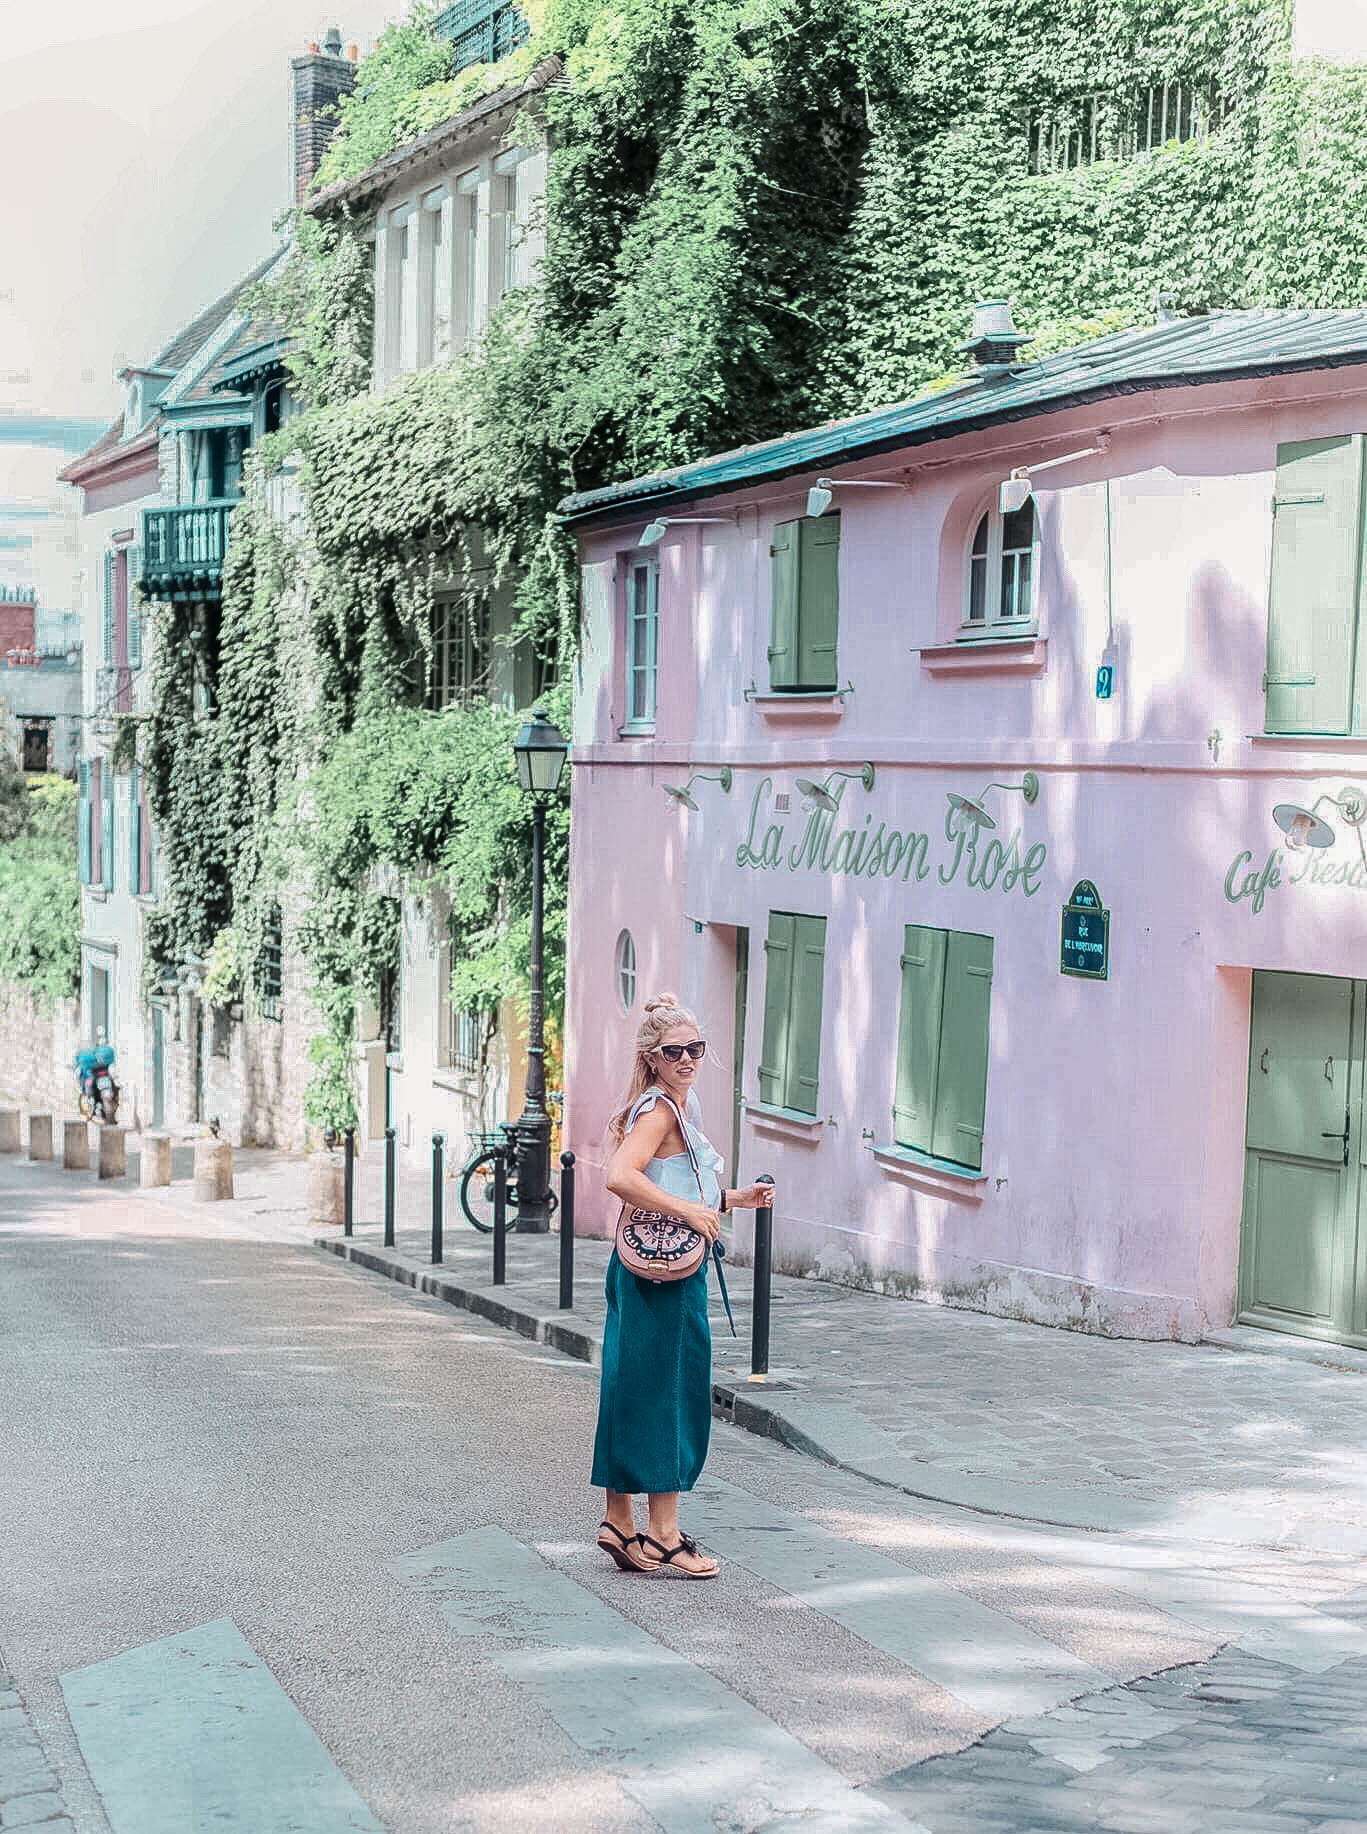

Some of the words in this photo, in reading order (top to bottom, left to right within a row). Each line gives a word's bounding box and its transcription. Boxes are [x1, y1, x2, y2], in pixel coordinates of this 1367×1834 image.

[736, 776, 784, 871] La
[788, 778, 931, 883] Maison
[938, 803, 1048, 897] Rose
[1224, 848, 1283, 915] Café
